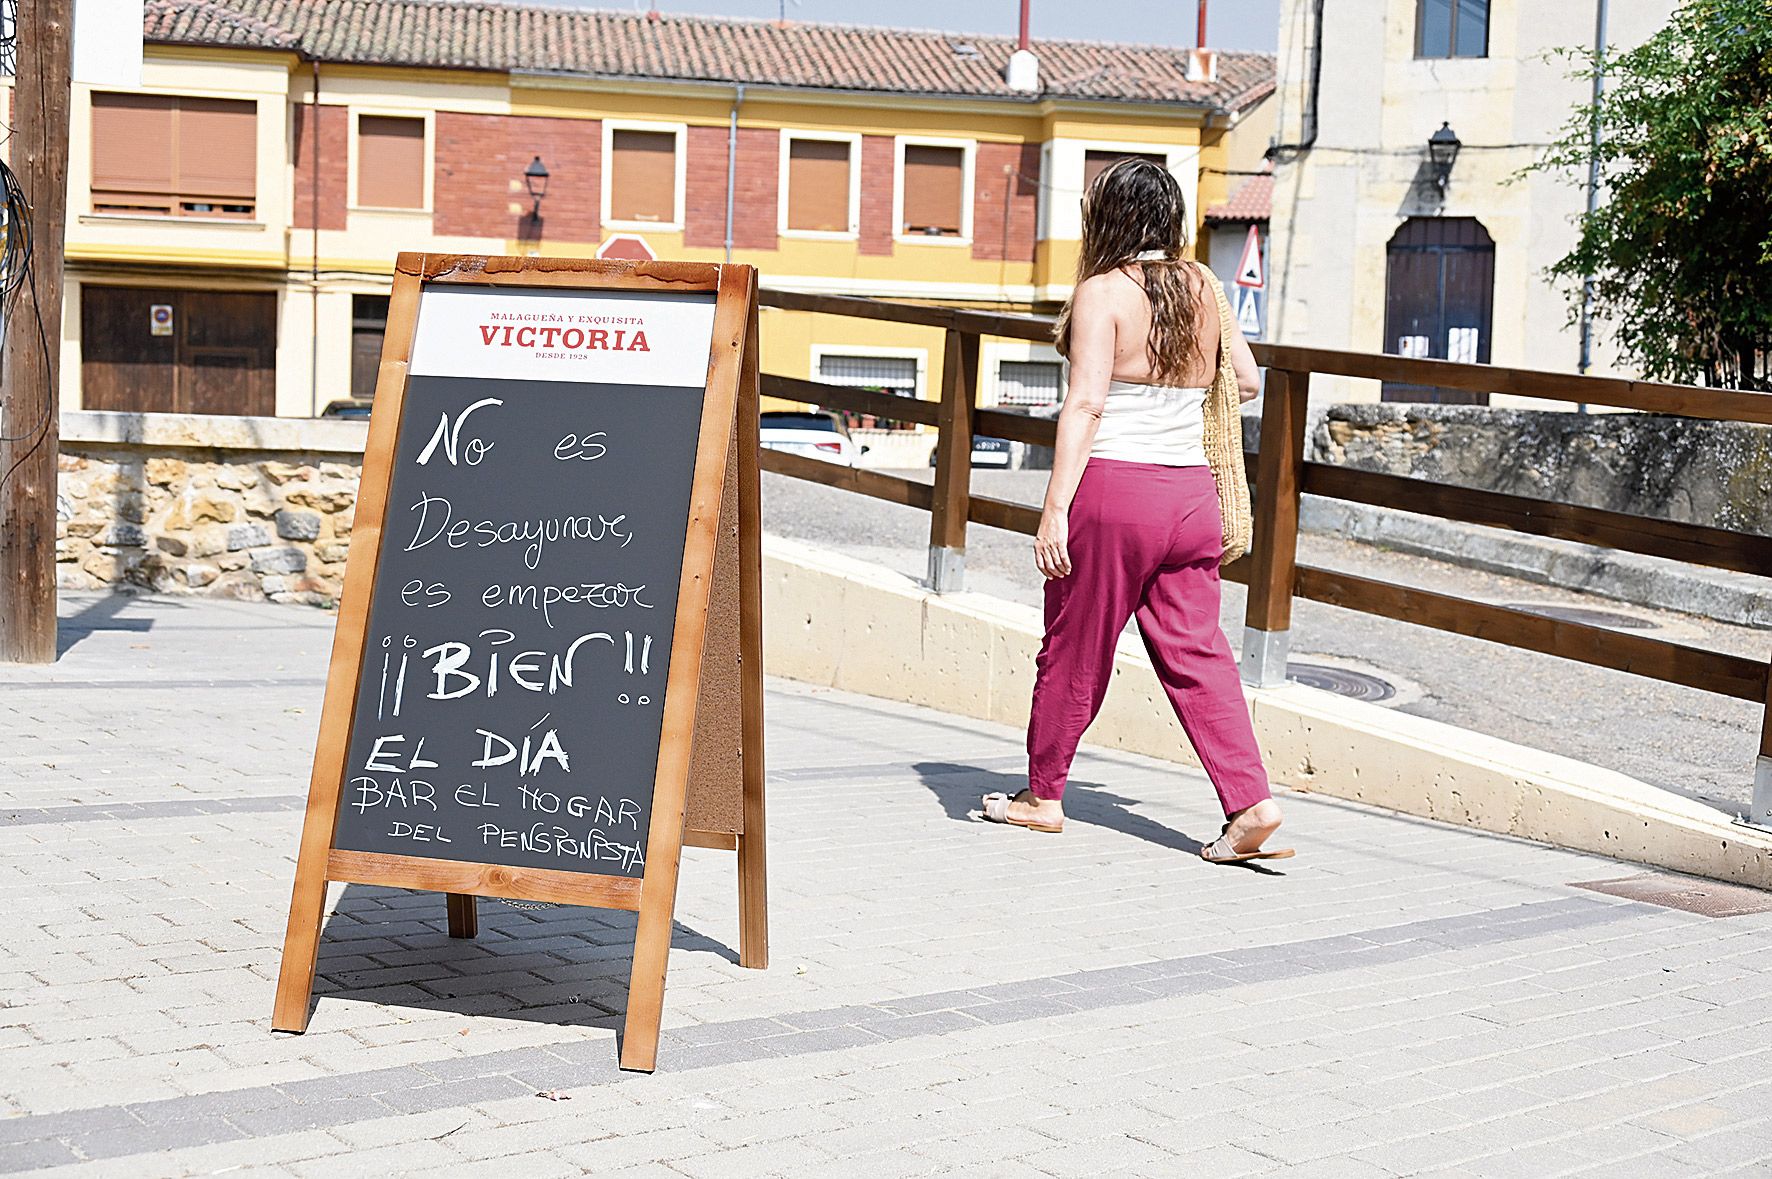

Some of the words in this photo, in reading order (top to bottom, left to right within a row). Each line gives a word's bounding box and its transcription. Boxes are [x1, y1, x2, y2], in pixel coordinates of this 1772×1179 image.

[478, 324, 651, 353] VICTORIA
[490, 312, 564, 323] MALAGUEÑA
[567, 315, 576, 323] Y
[578, 315, 645, 326] EXQUISITA
[535, 352, 566, 360] DESDE
[415, 397, 504, 466] No
[553, 431, 607, 461] es
[403, 490, 633, 570] Desayunar,
[401, 579, 452, 608] es
[482, 582, 654, 629] empezar
[364, 734, 439, 773] EL
[471, 712, 571, 778] DÍA
[350, 776, 438, 815] BAR
[454, 782, 500, 808] EL
[517, 783, 643, 831] HOGAR
[387, 821, 452, 843] DEL
